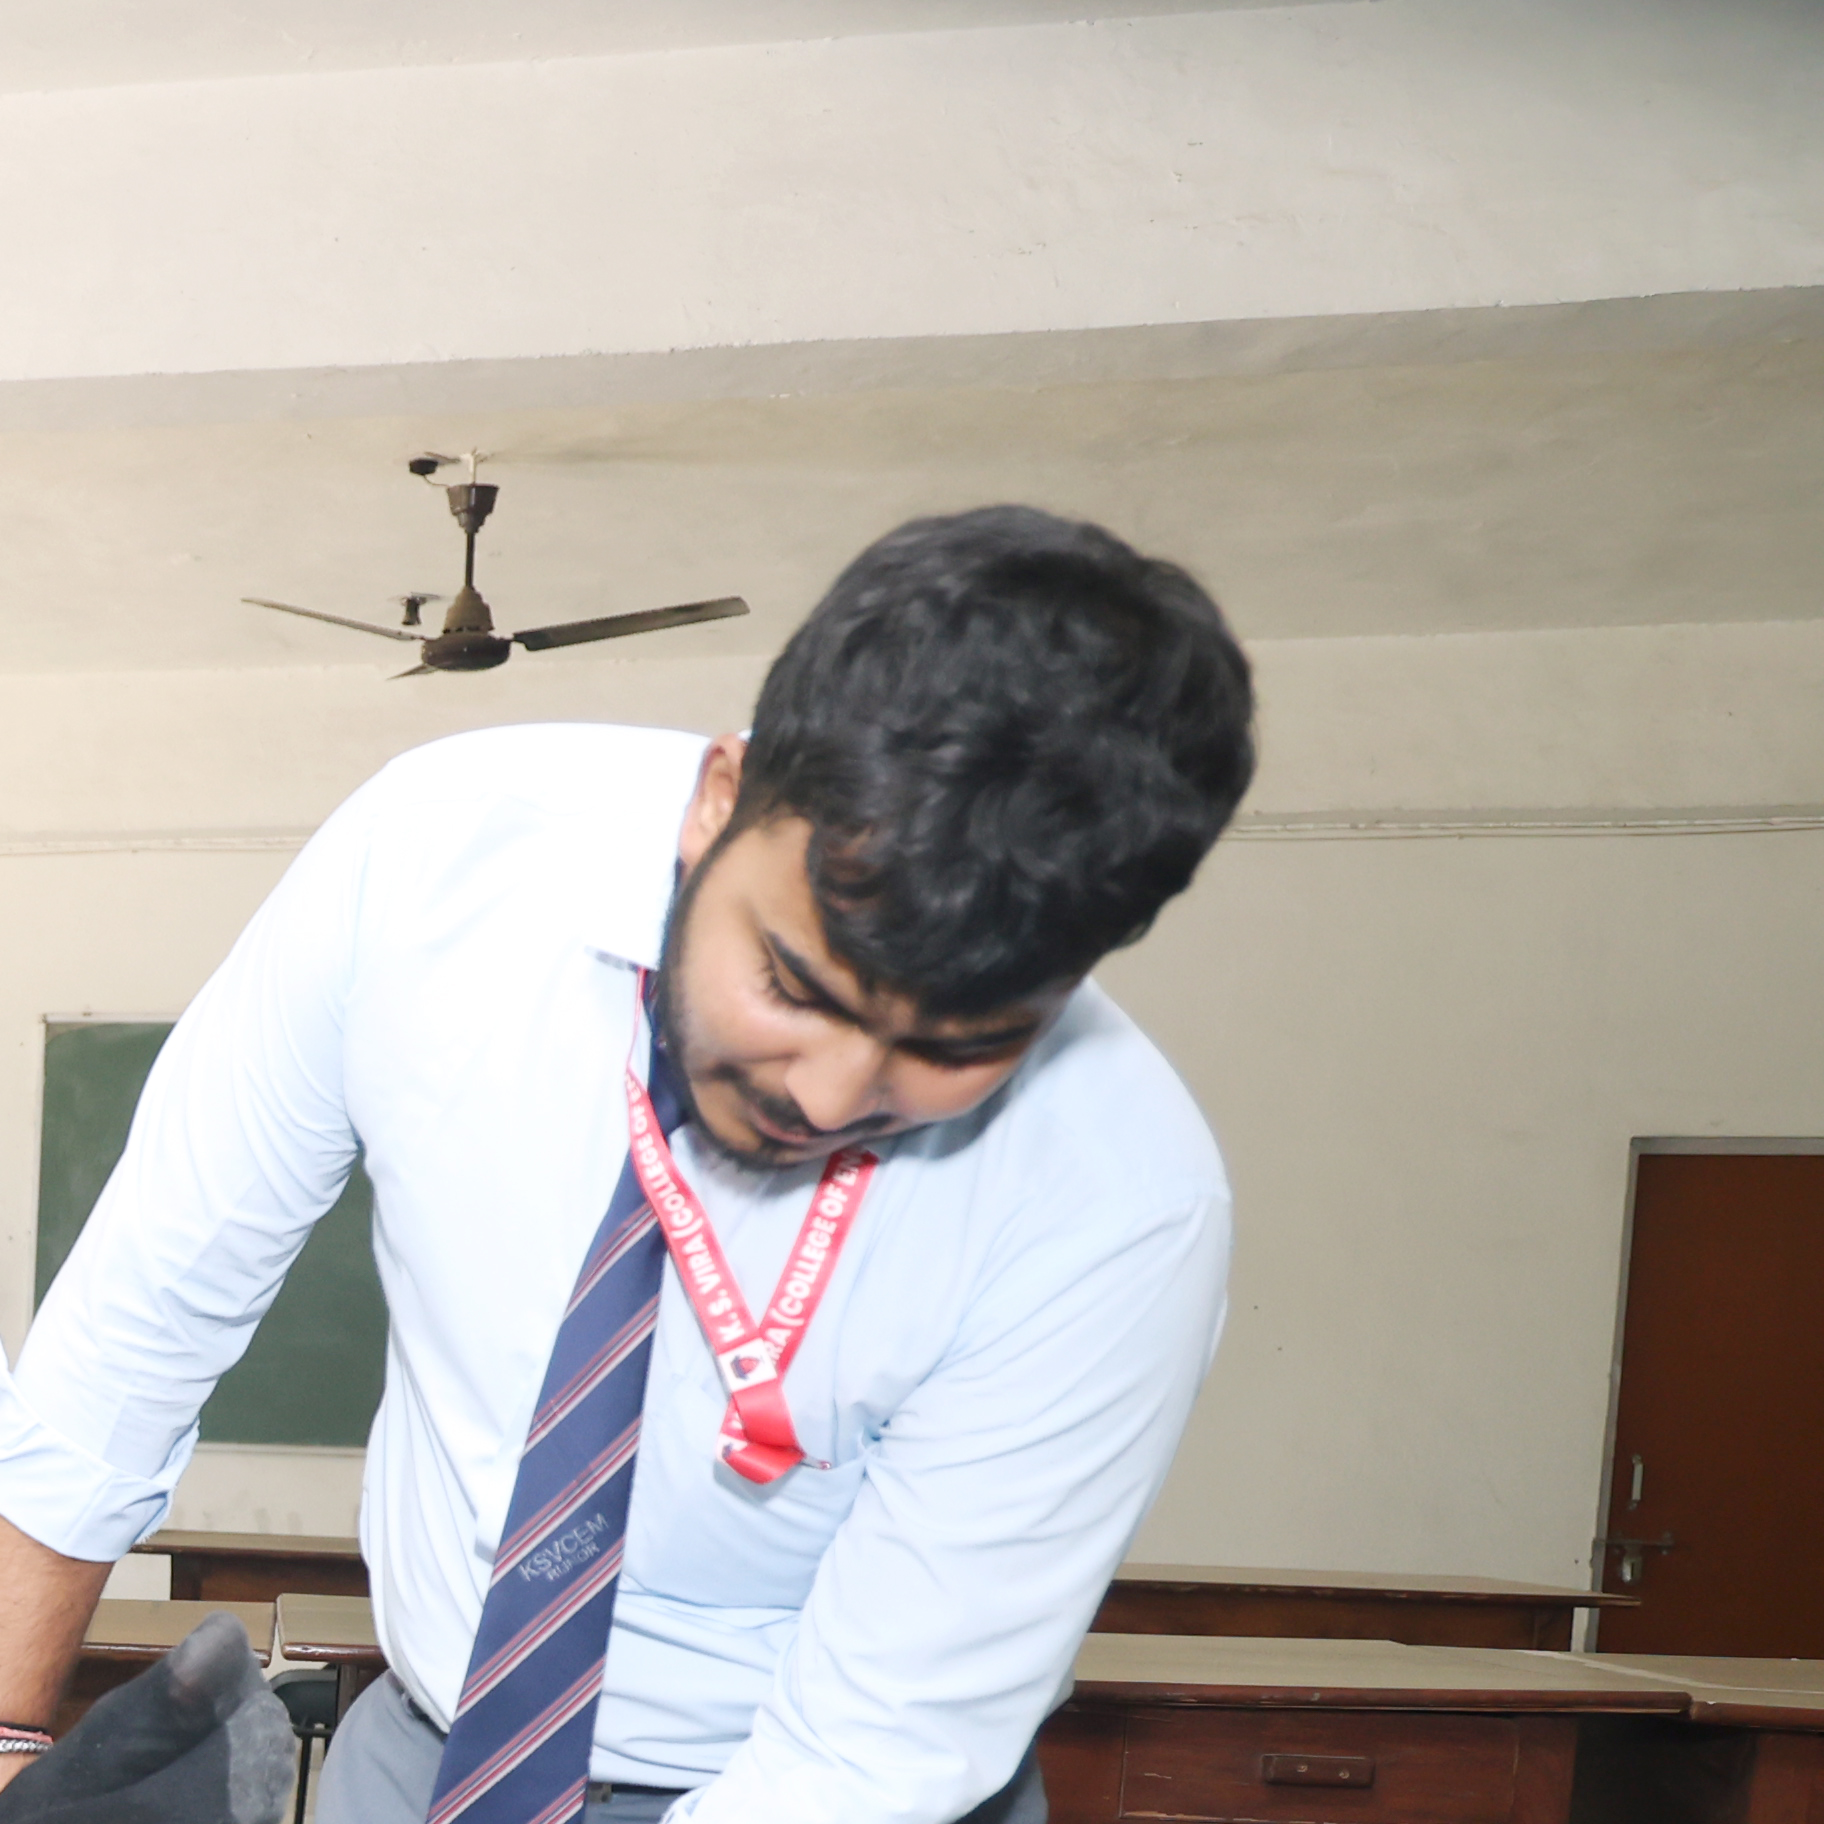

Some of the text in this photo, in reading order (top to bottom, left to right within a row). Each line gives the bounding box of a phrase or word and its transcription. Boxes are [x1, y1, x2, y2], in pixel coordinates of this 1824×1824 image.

[632, 1105, 648, 1134] OF
[637, 1133, 703, 1238] (COLLEGE
[682, 1230, 722, 1294] VIRA
[772, 1216, 838, 1327] (COLLEGE
[818, 1182, 848, 1218] OF
[708, 1291, 736, 1317] S.
[716, 1316, 745, 1343] K.
[517, 1512, 610, 1581] KSVCEM
